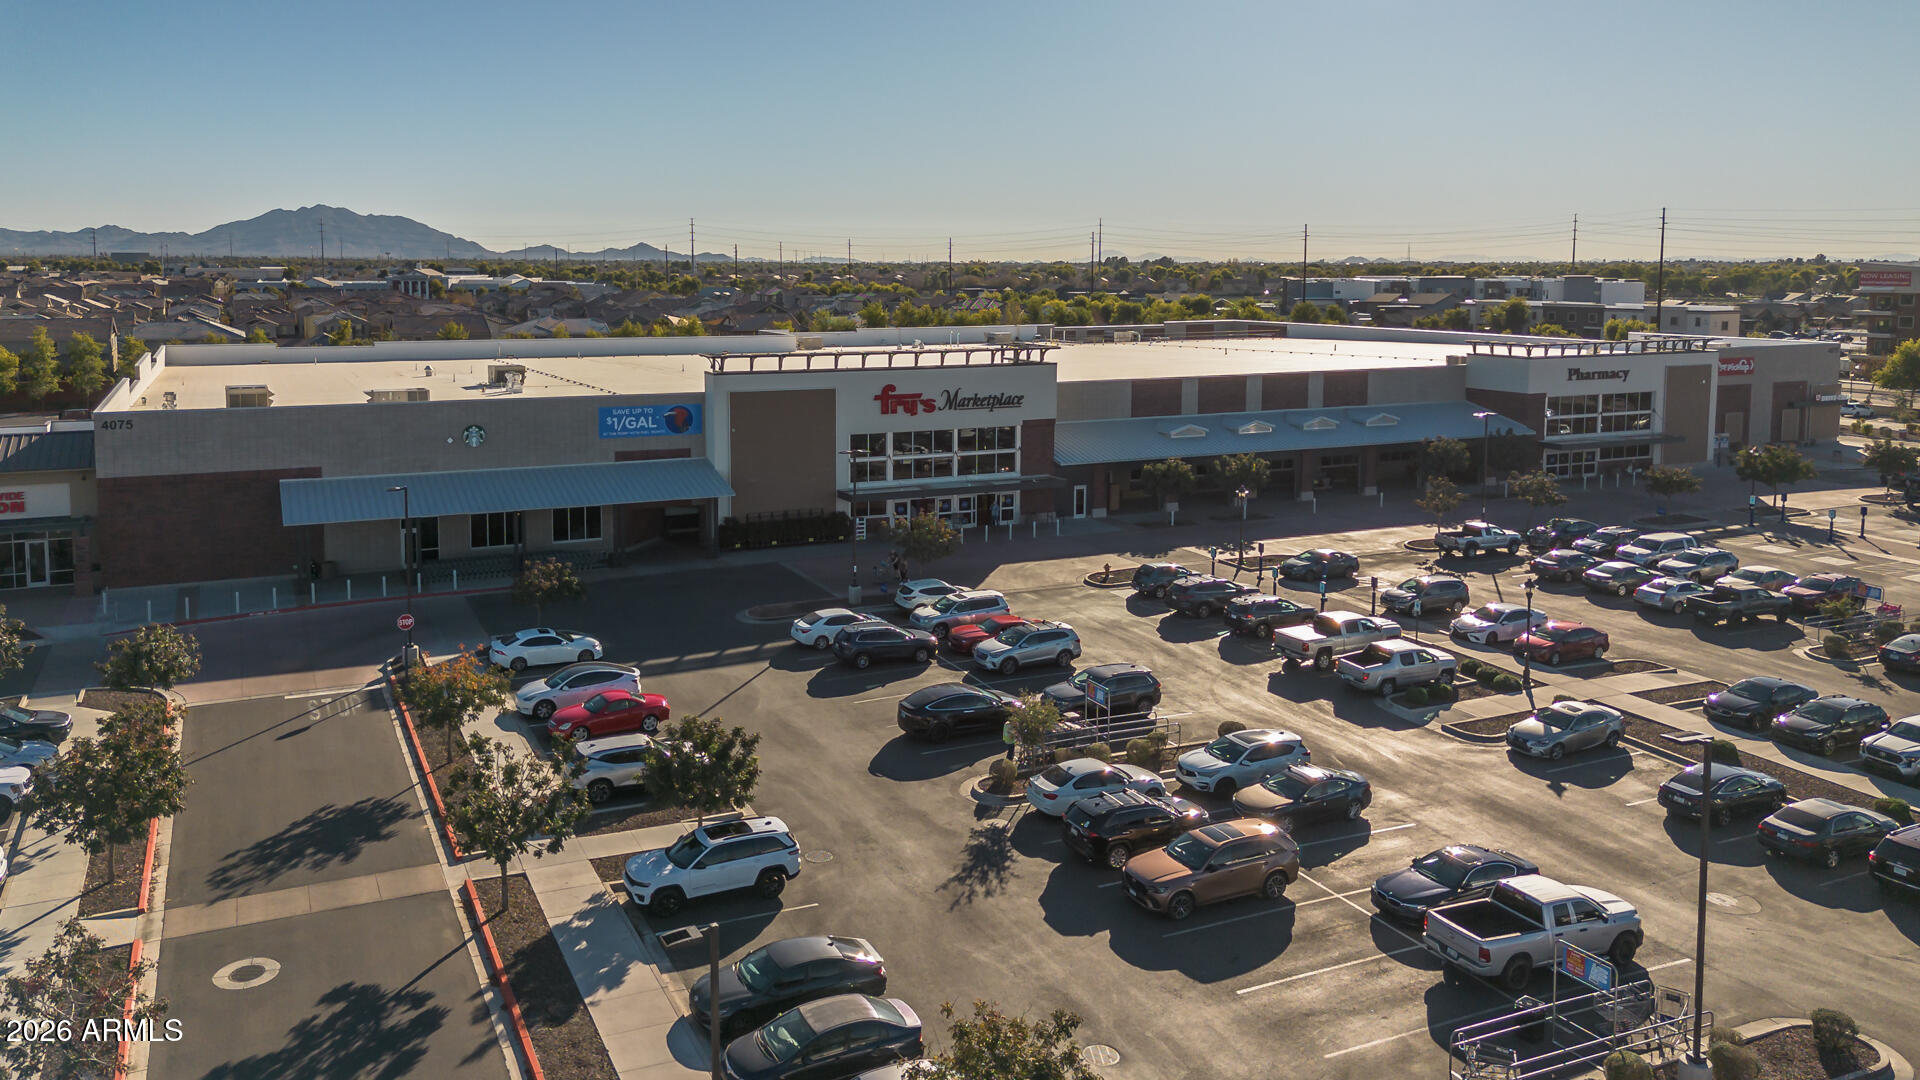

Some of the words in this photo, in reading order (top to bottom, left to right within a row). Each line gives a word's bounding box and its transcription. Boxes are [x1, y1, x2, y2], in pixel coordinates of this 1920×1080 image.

[1567, 367, 1631, 382] Pharmacy
[938, 387, 1025, 412] Marketplace
[101, 419, 134, 430] 4075
[399, 618, 413, 626] STOP
[309, 694, 362, 721] STOP
